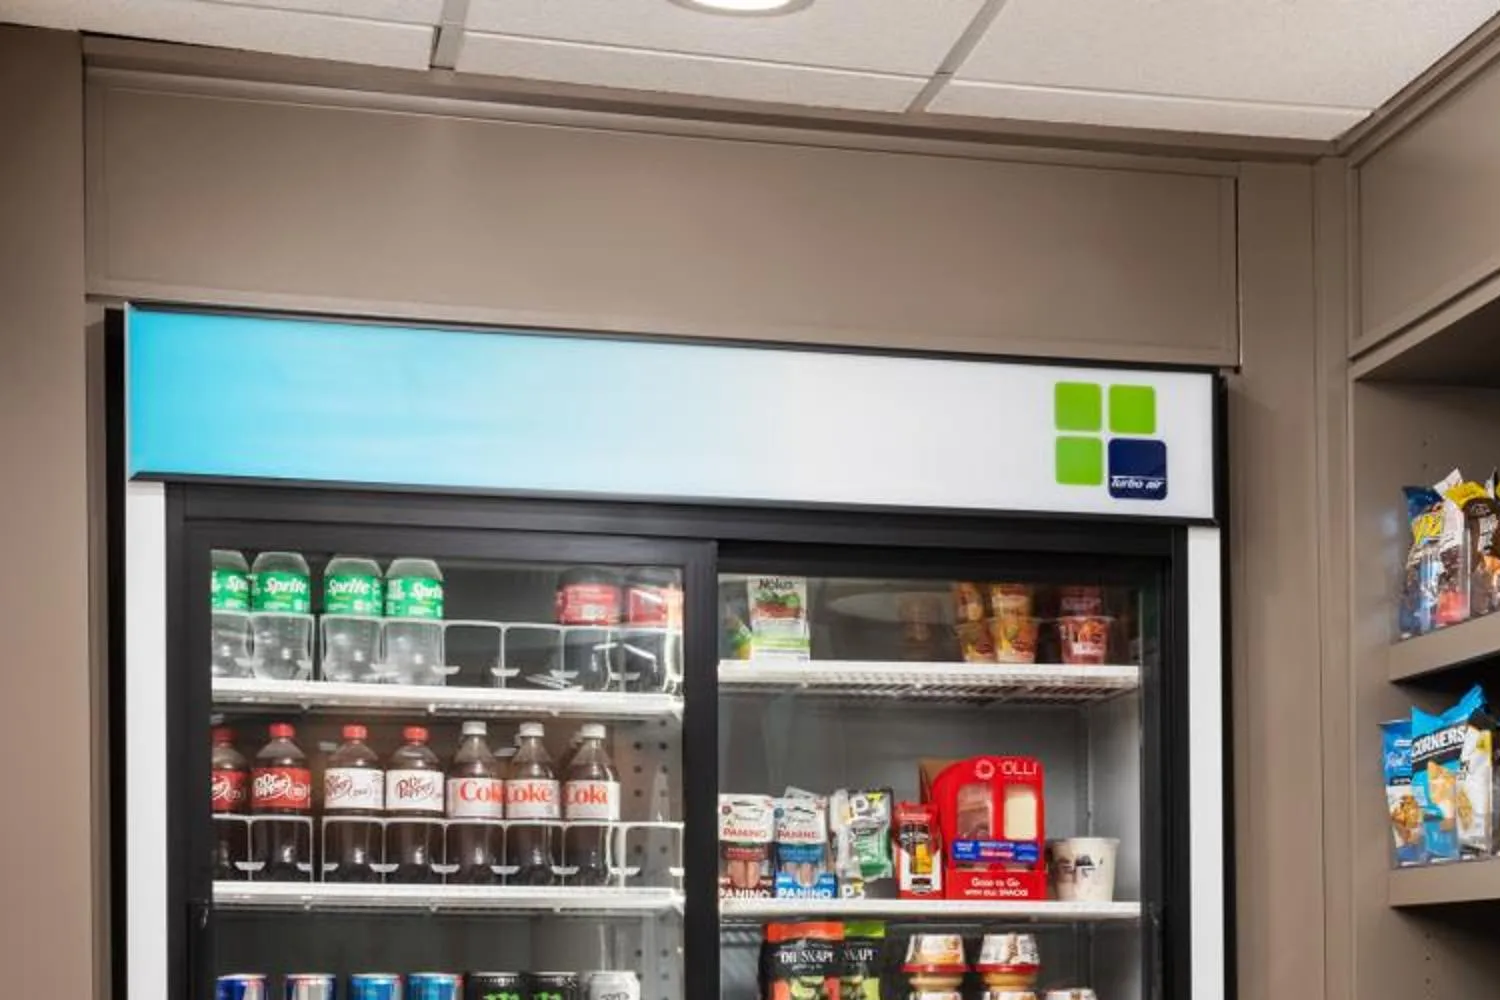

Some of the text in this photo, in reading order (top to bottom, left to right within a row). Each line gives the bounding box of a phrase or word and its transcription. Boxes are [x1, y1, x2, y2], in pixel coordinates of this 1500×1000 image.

[328, 578, 371, 596] Sprite
[1002, 761, 1037, 776] OLLI
[719, 888, 771, 899] PANINO
[777, 888, 833, 899] PANINO
